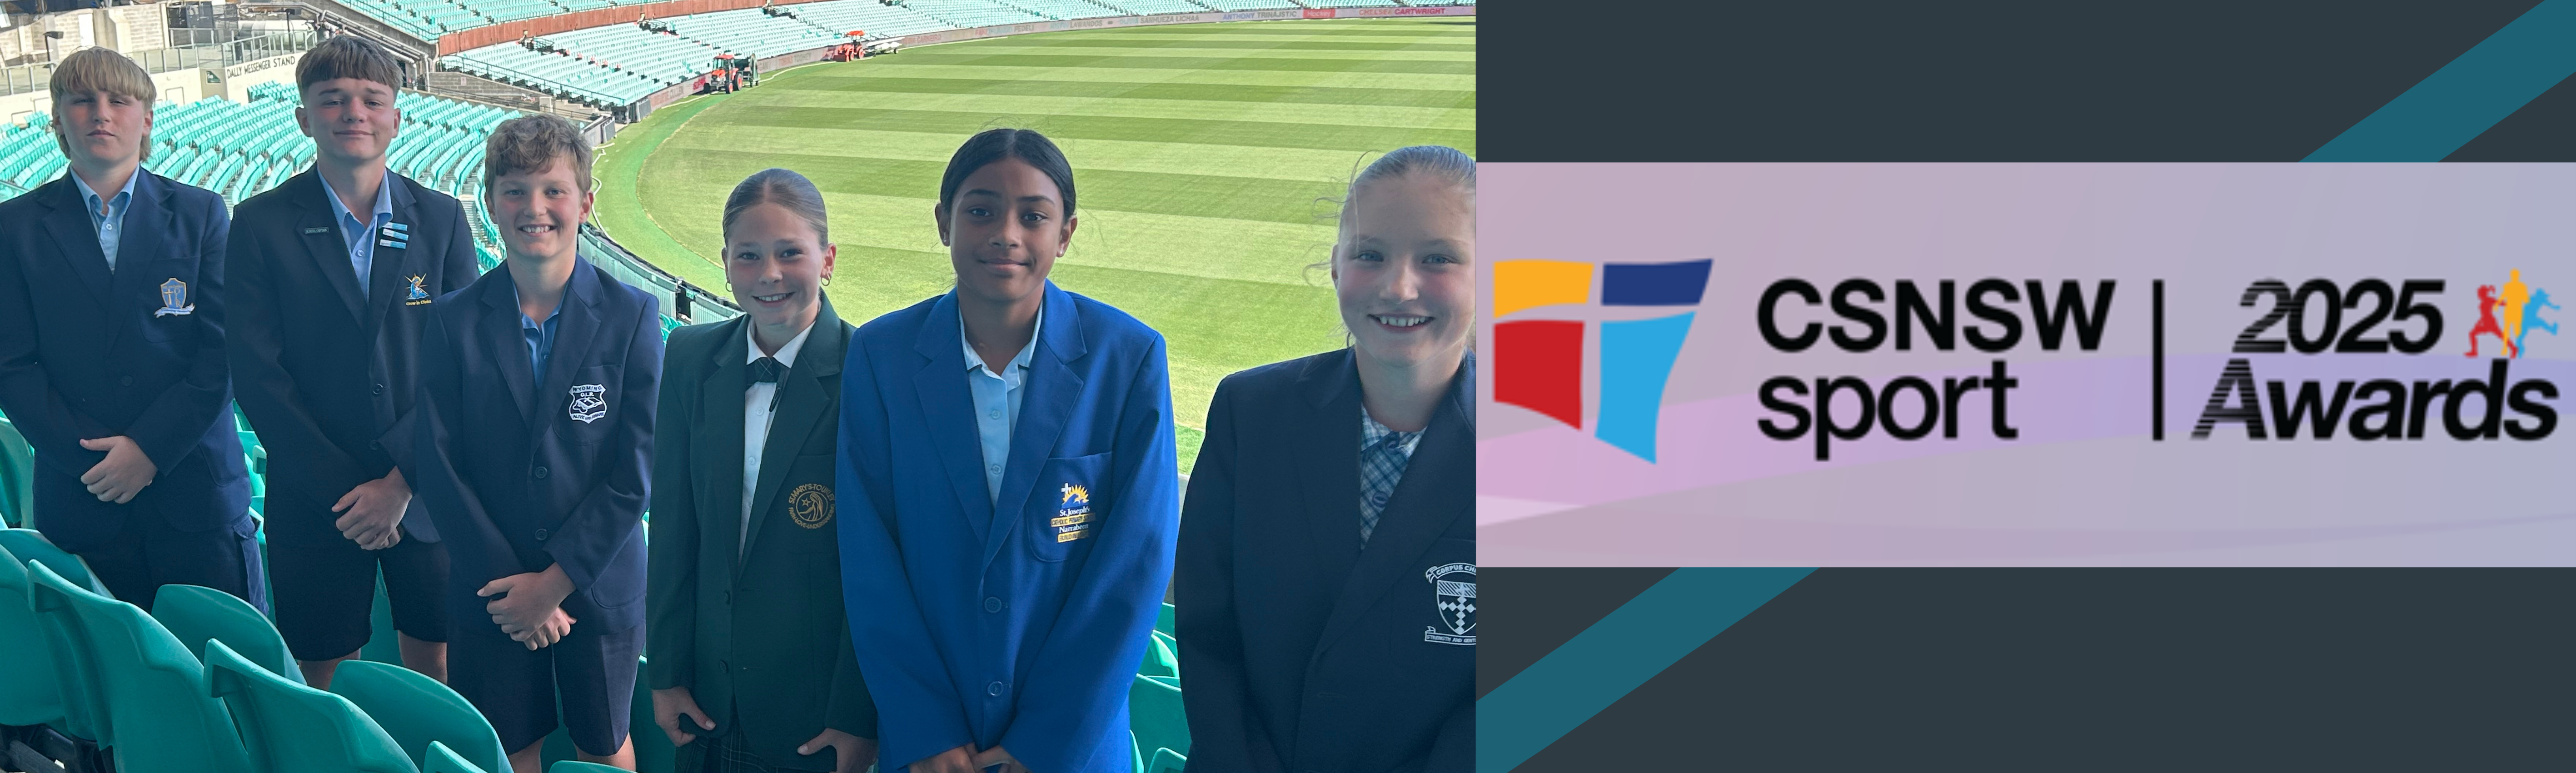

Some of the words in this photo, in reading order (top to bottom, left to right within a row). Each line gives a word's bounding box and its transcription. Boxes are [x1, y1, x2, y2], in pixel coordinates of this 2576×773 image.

[1014, 24, 1034, 32] FEDELI
[1070, 20, 1102, 28] LAWANDOS
[227, 66, 242, 79] DALLY
[244, 60, 271, 75] MESSENGER
[273, 56, 295, 68] STAND
[1059, 524, 1089, 533] Narrabeen
[1436, 565, 1463, 575] CORPUS
